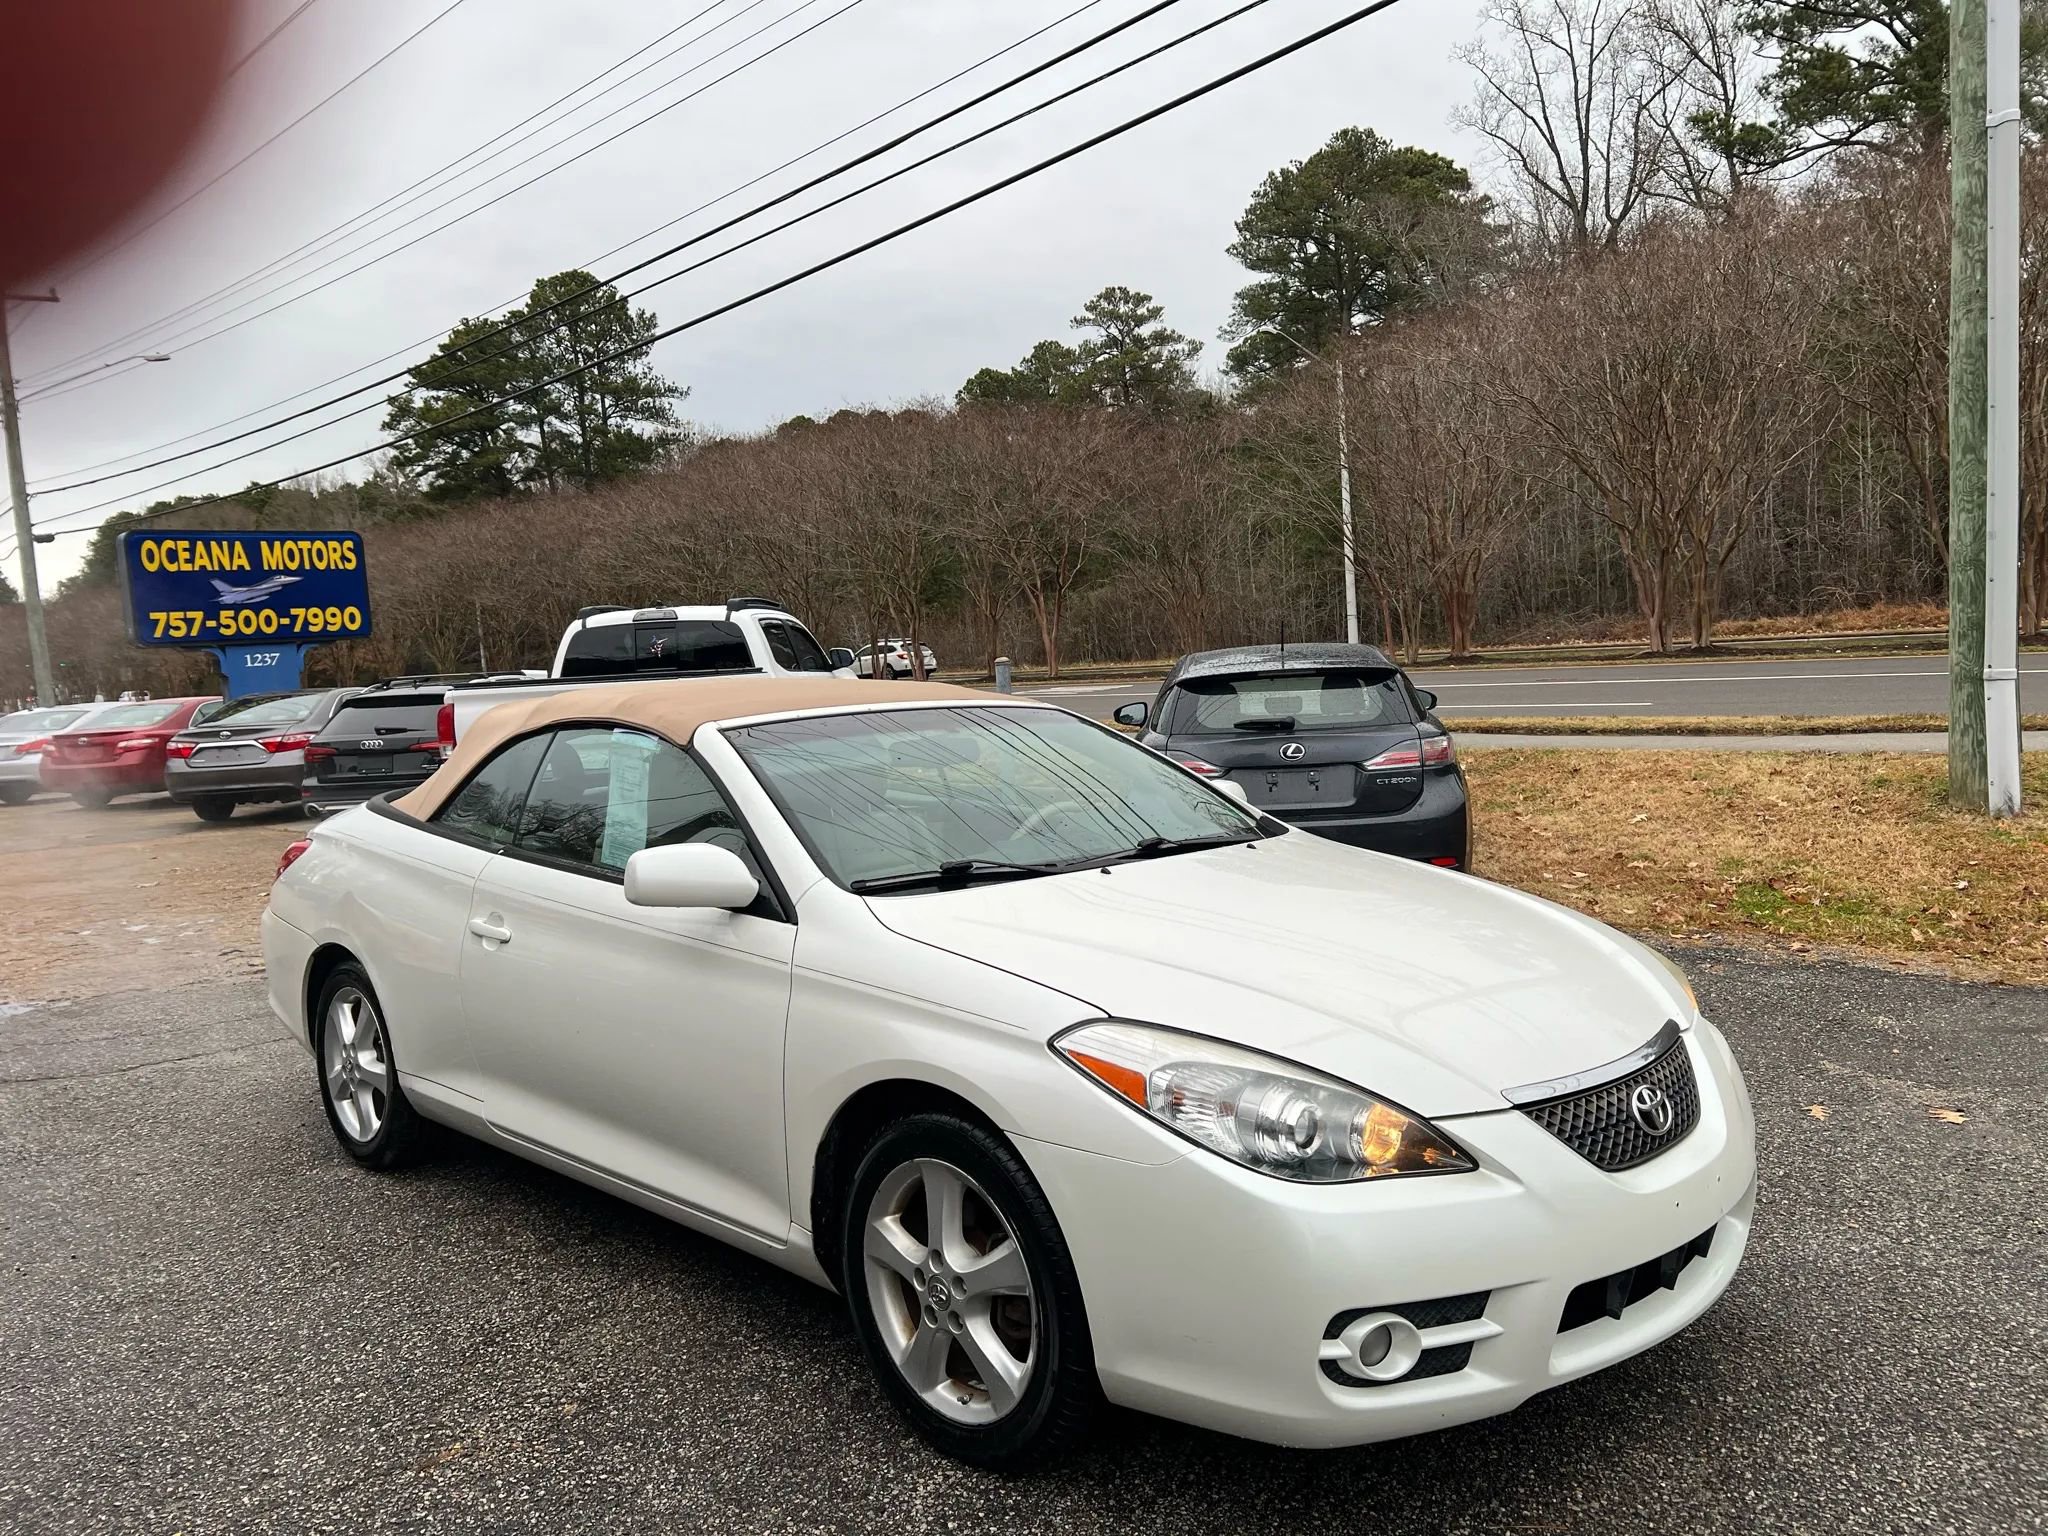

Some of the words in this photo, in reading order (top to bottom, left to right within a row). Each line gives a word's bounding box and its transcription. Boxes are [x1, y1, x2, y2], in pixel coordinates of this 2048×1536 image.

[141, 539, 250, 572] OCEANA
[260, 540, 357, 571] MOTORS
[149, 606, 362, 638] 757-500-7990
[244, 652, 280, 667] 1237
